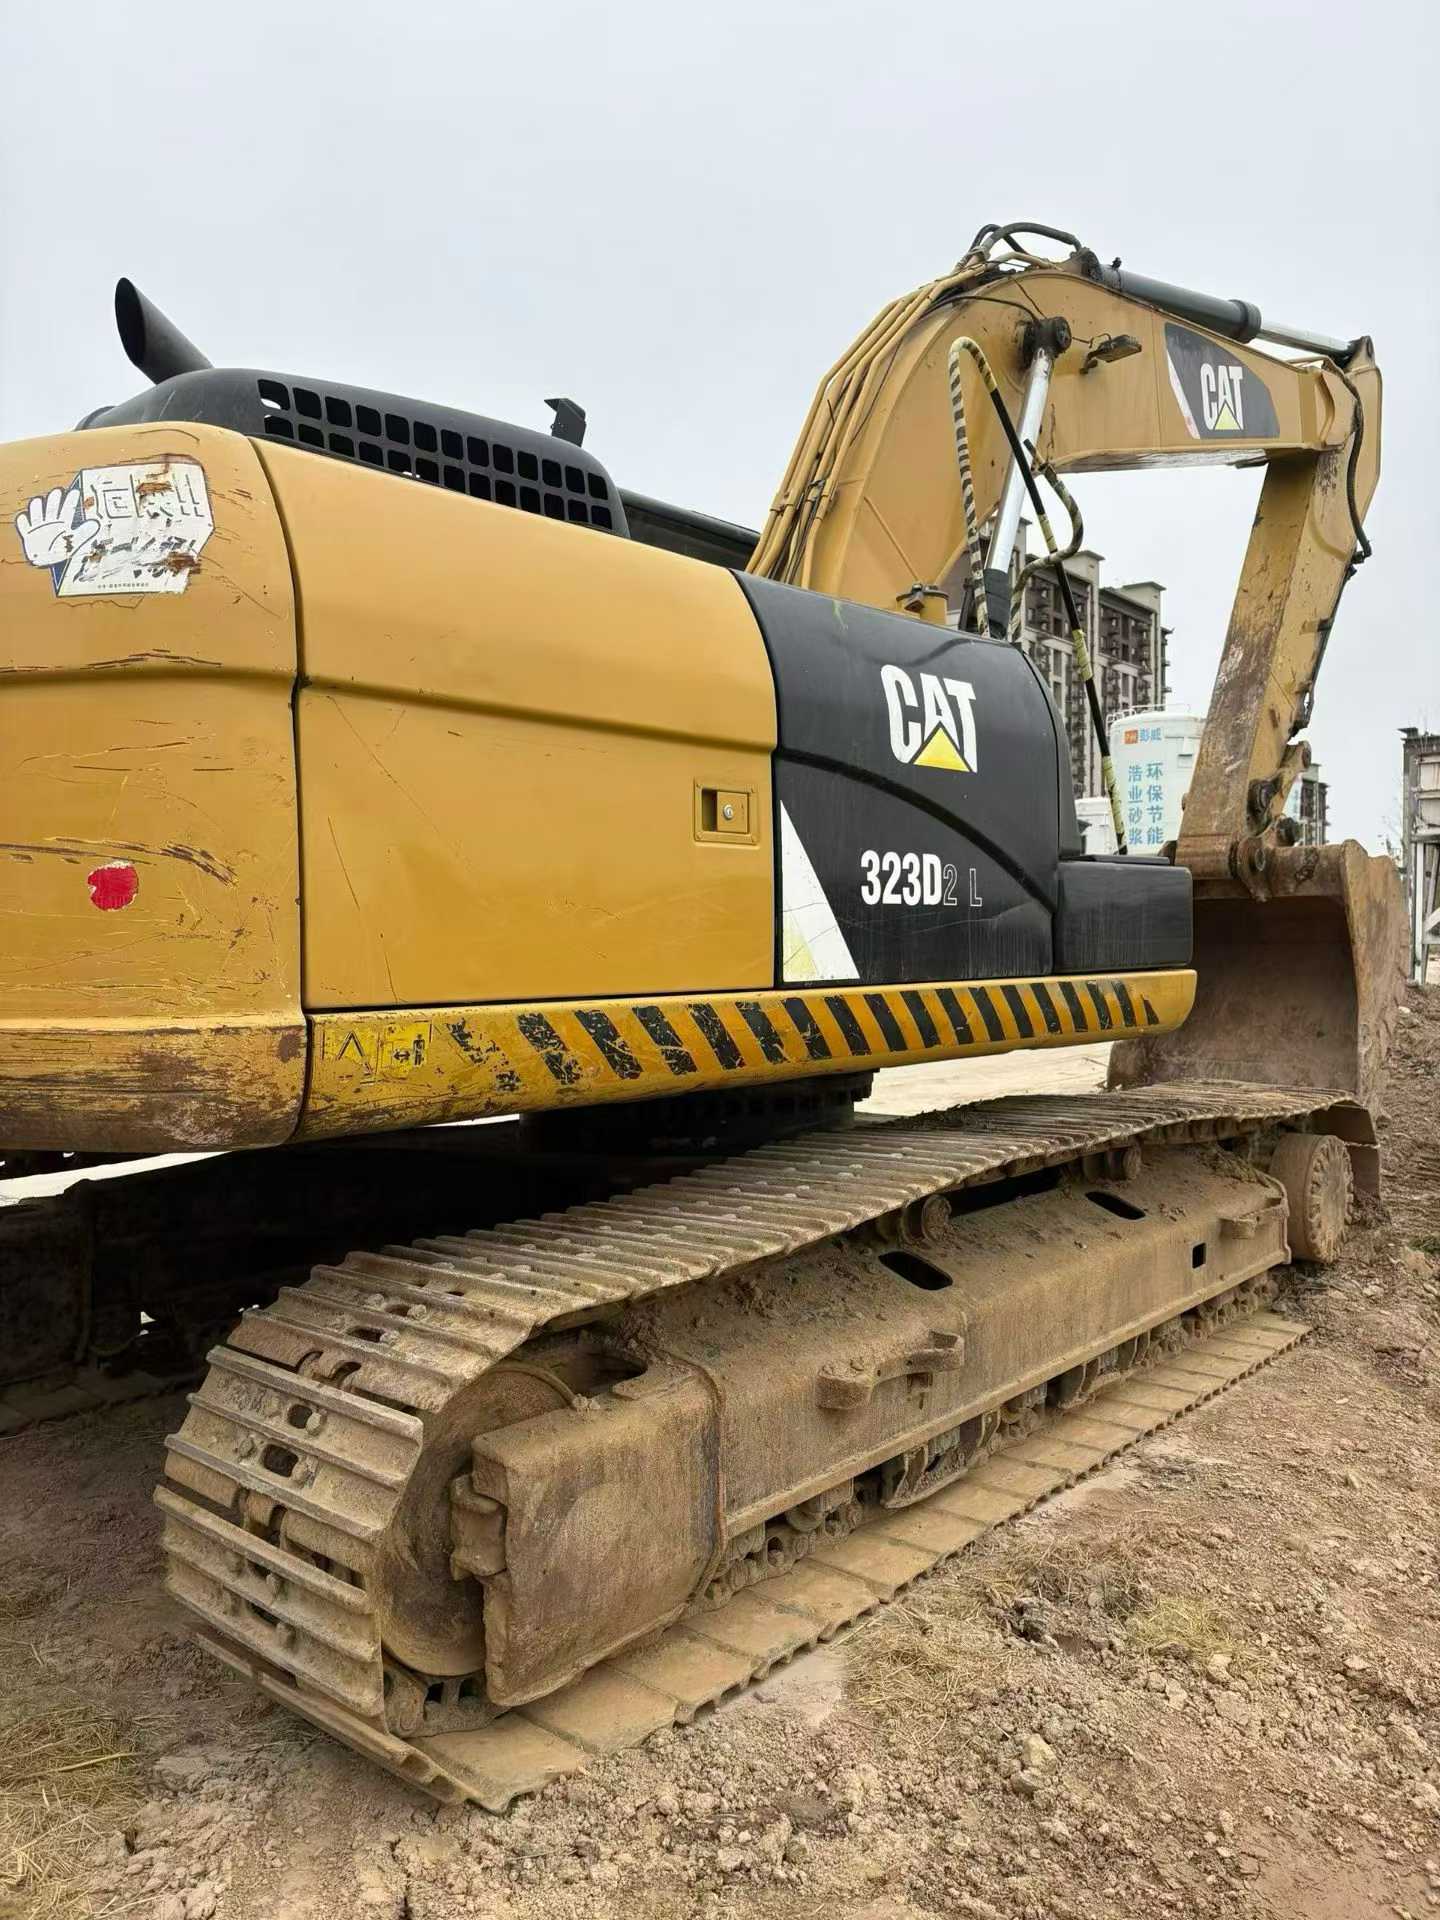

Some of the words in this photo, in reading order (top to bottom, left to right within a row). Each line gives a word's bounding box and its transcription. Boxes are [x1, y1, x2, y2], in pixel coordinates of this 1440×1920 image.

[1200, 363, 1244, 430] CAT
[880, 664, 978, 774] CAT
[1128, 764, 1143, 845] 浩业砂浆
[1146, 762, 1164, 845] 环保节能
[969, 867, 983, 907] L
